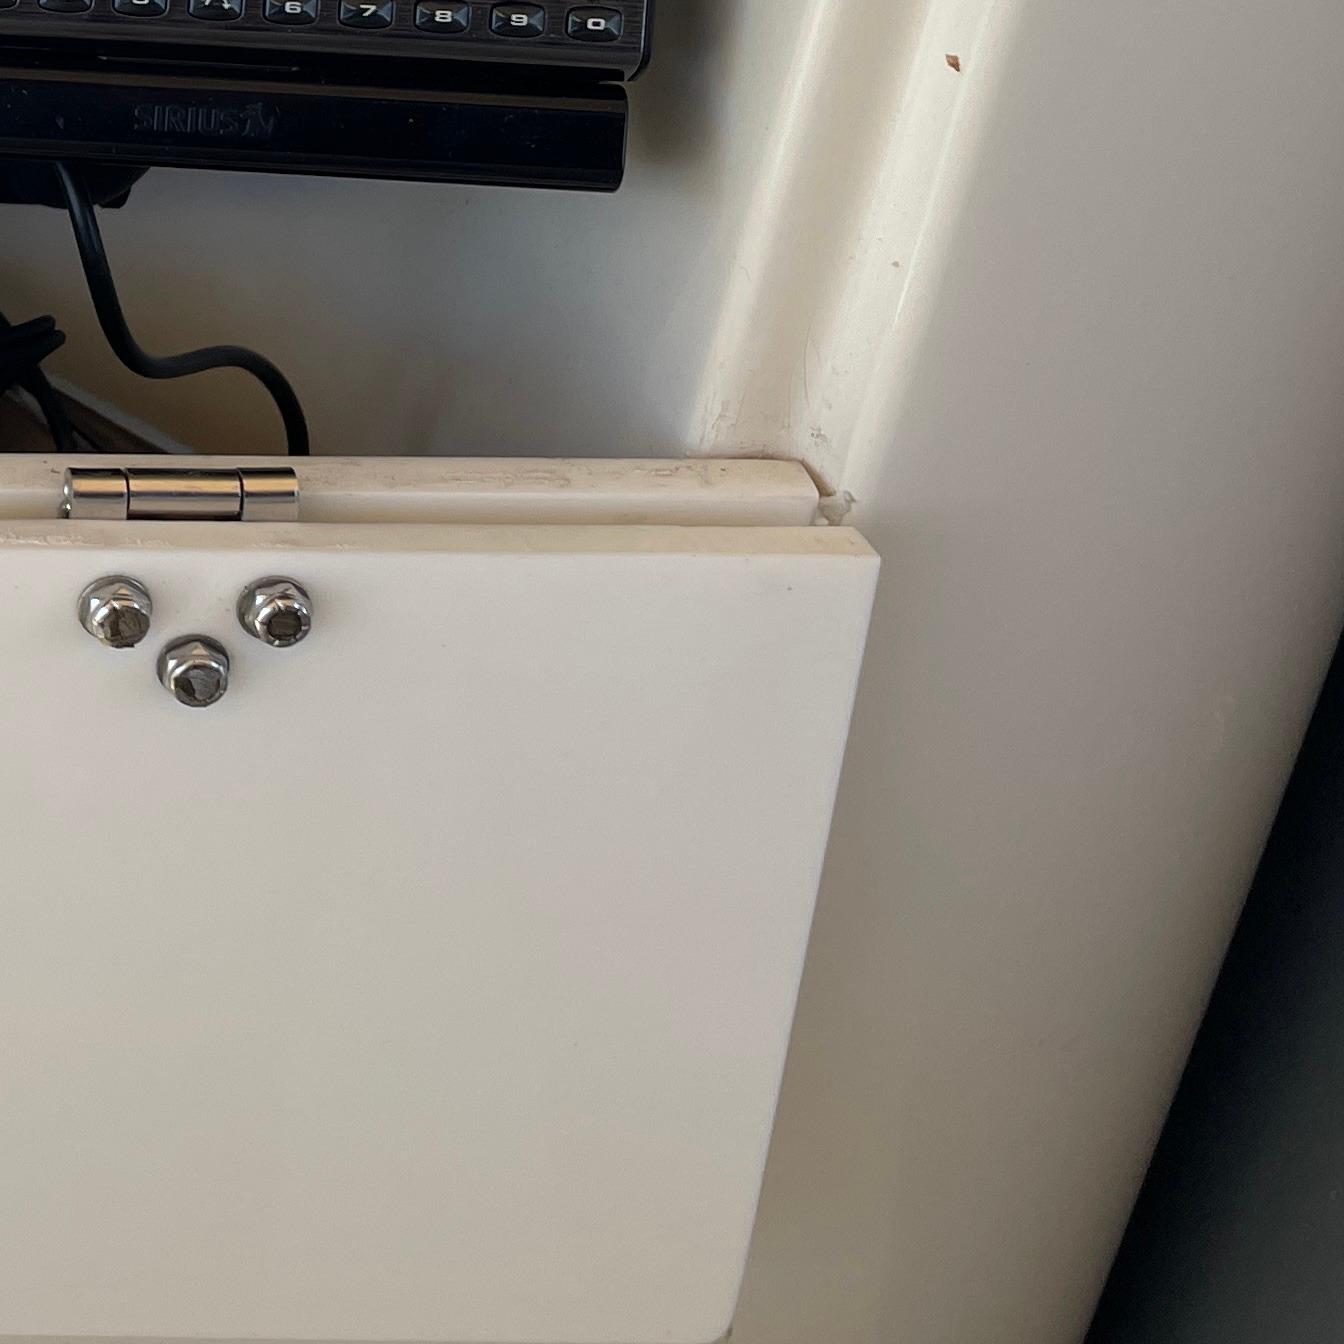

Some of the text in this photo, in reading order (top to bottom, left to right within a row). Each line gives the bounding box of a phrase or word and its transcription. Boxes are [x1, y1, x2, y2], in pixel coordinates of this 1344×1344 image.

[283, 0, 302, 13] 6
[359, 4, 377, 18] 7
[434, 9, 453, 23] 8
[510, 13, 528, 27] 9
[133, 102, 239, 135] SIRIUS
